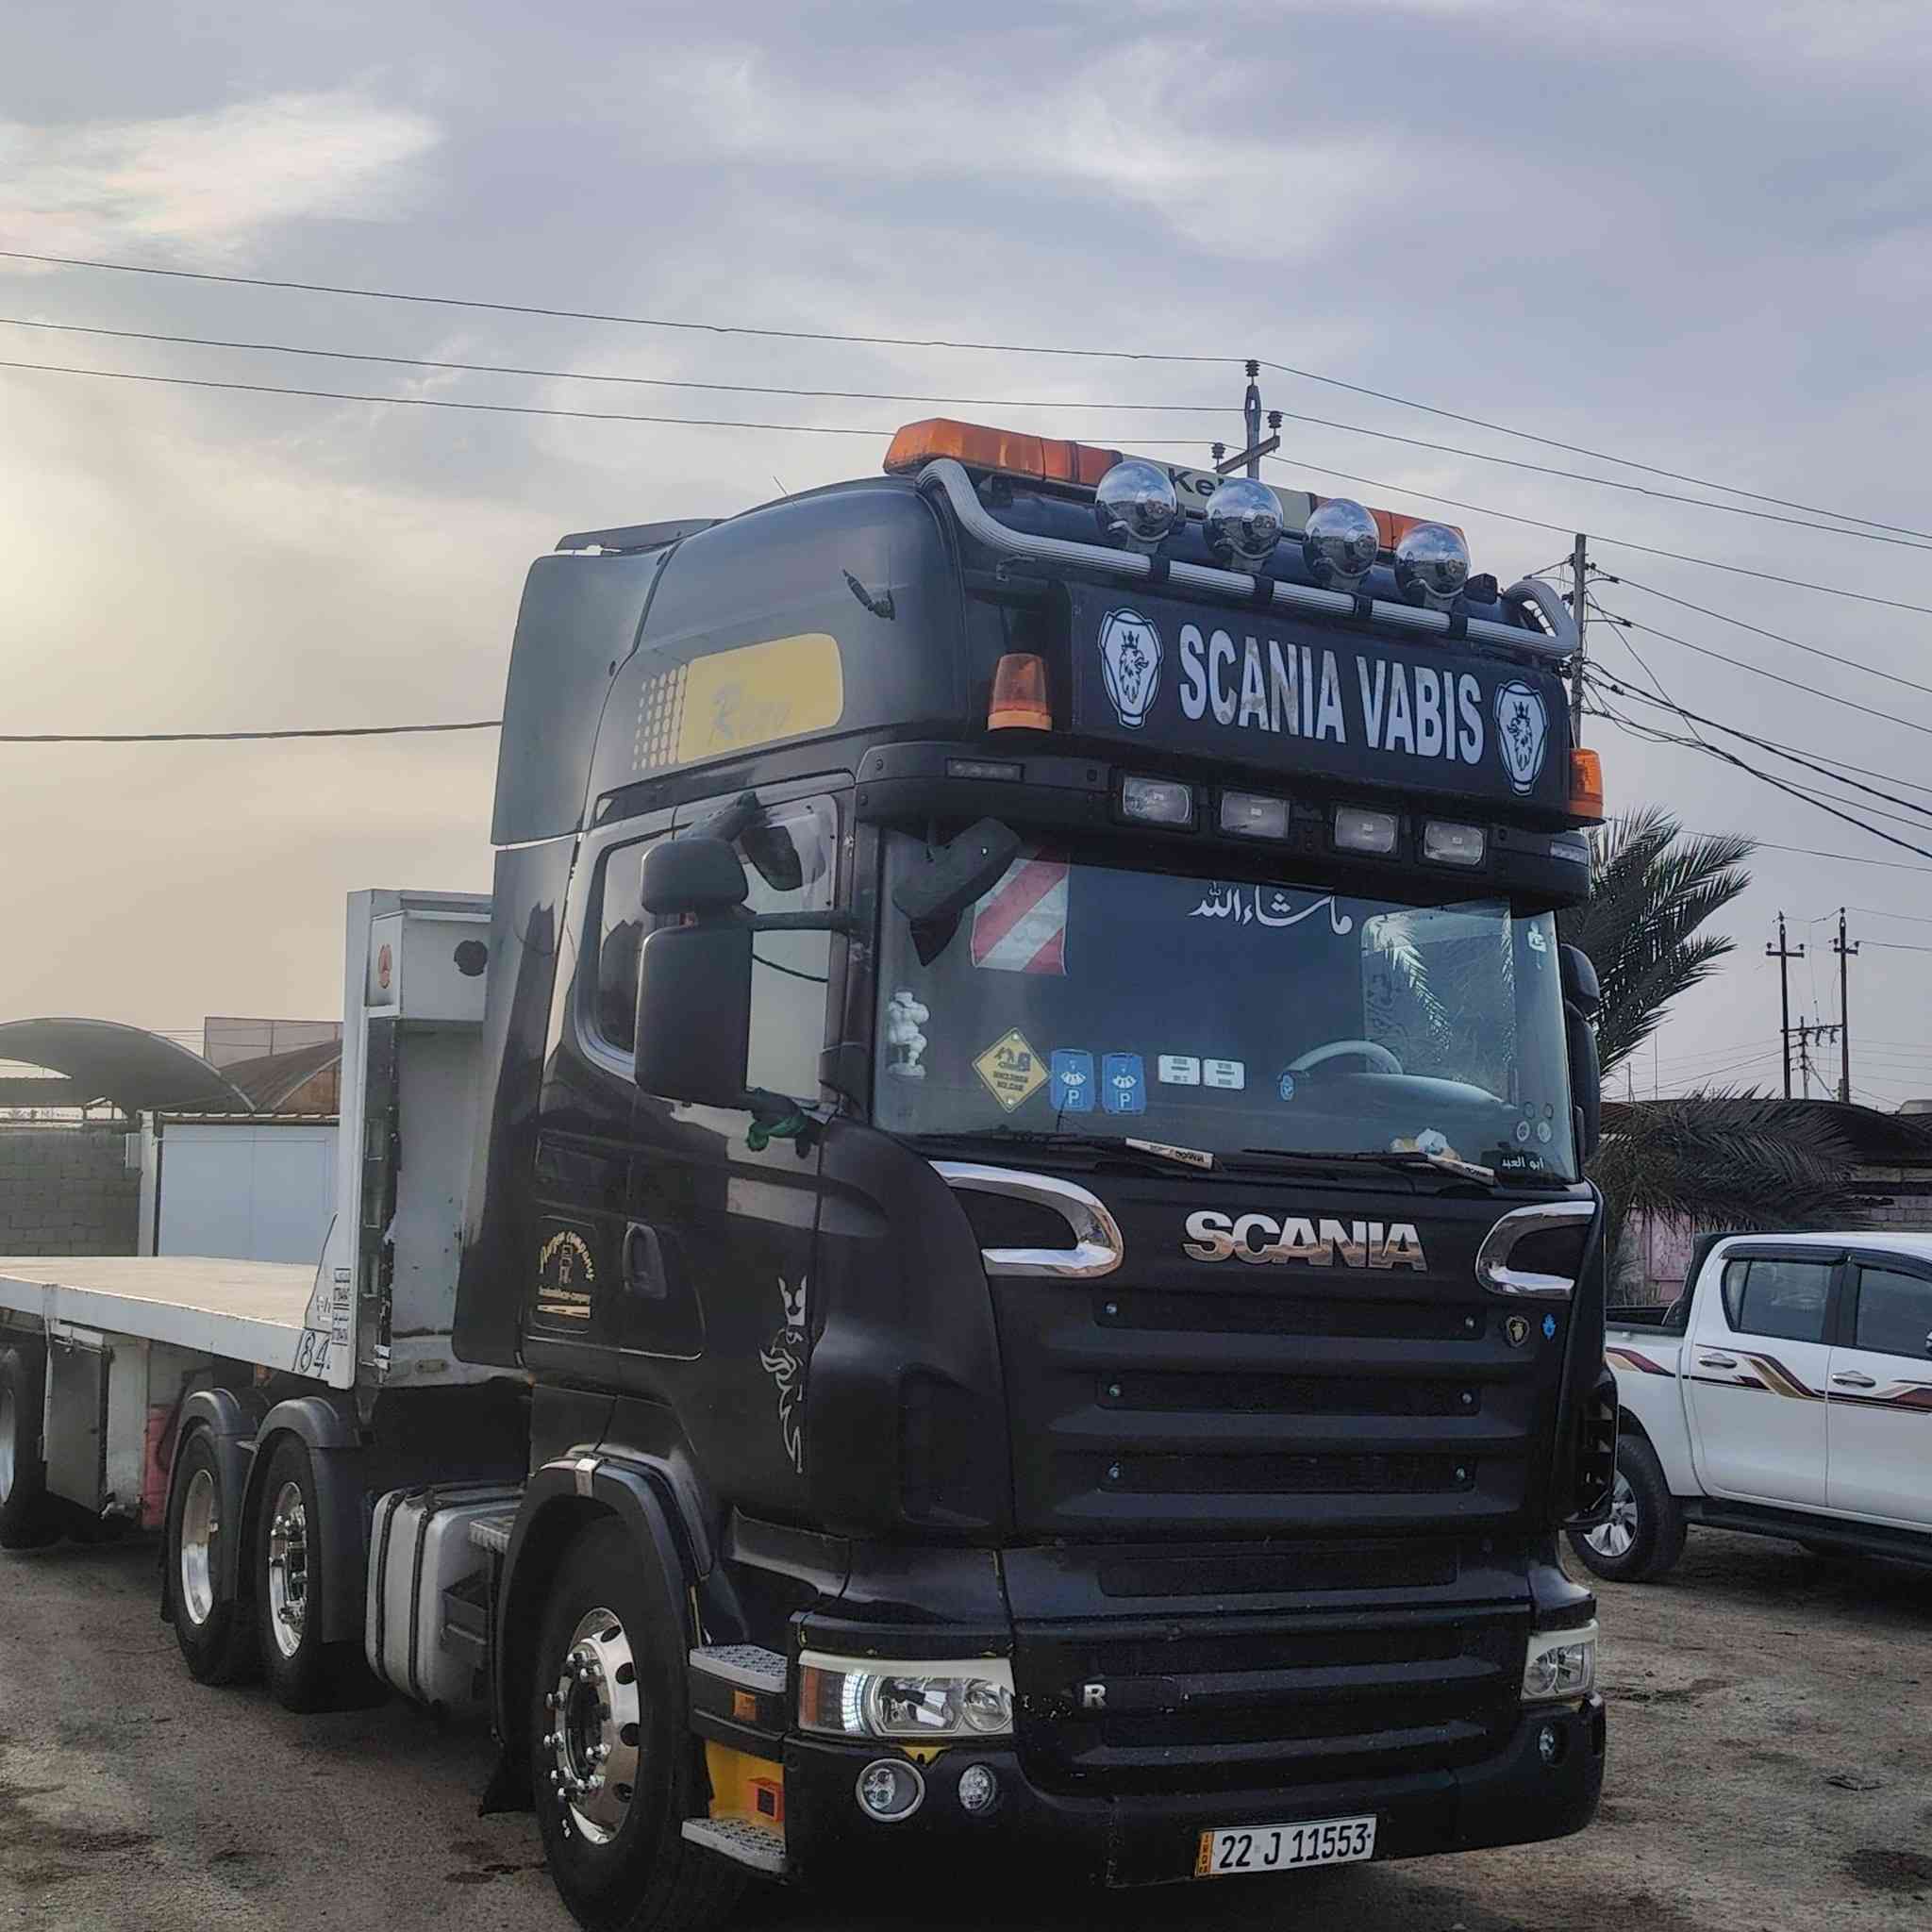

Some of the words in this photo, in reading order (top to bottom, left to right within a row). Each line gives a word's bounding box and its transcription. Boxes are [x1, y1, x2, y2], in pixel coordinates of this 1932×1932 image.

[1179, 624, 1346, 743] SCANIA
[1357, 656, 1485, 765] VABIS
[1068, 1090, 1080, 1105] P
[1119, 1092, 1132, 1108] P
[1182, 1209, 1428, 1272] SCANIA
[1082, 1683, 1108, 1709] R
[1219, 1835, 1253, 1869] 22
[1263, 1832, 1281, 1865] J
[1290, 1824, 1369, 1863] 11553
